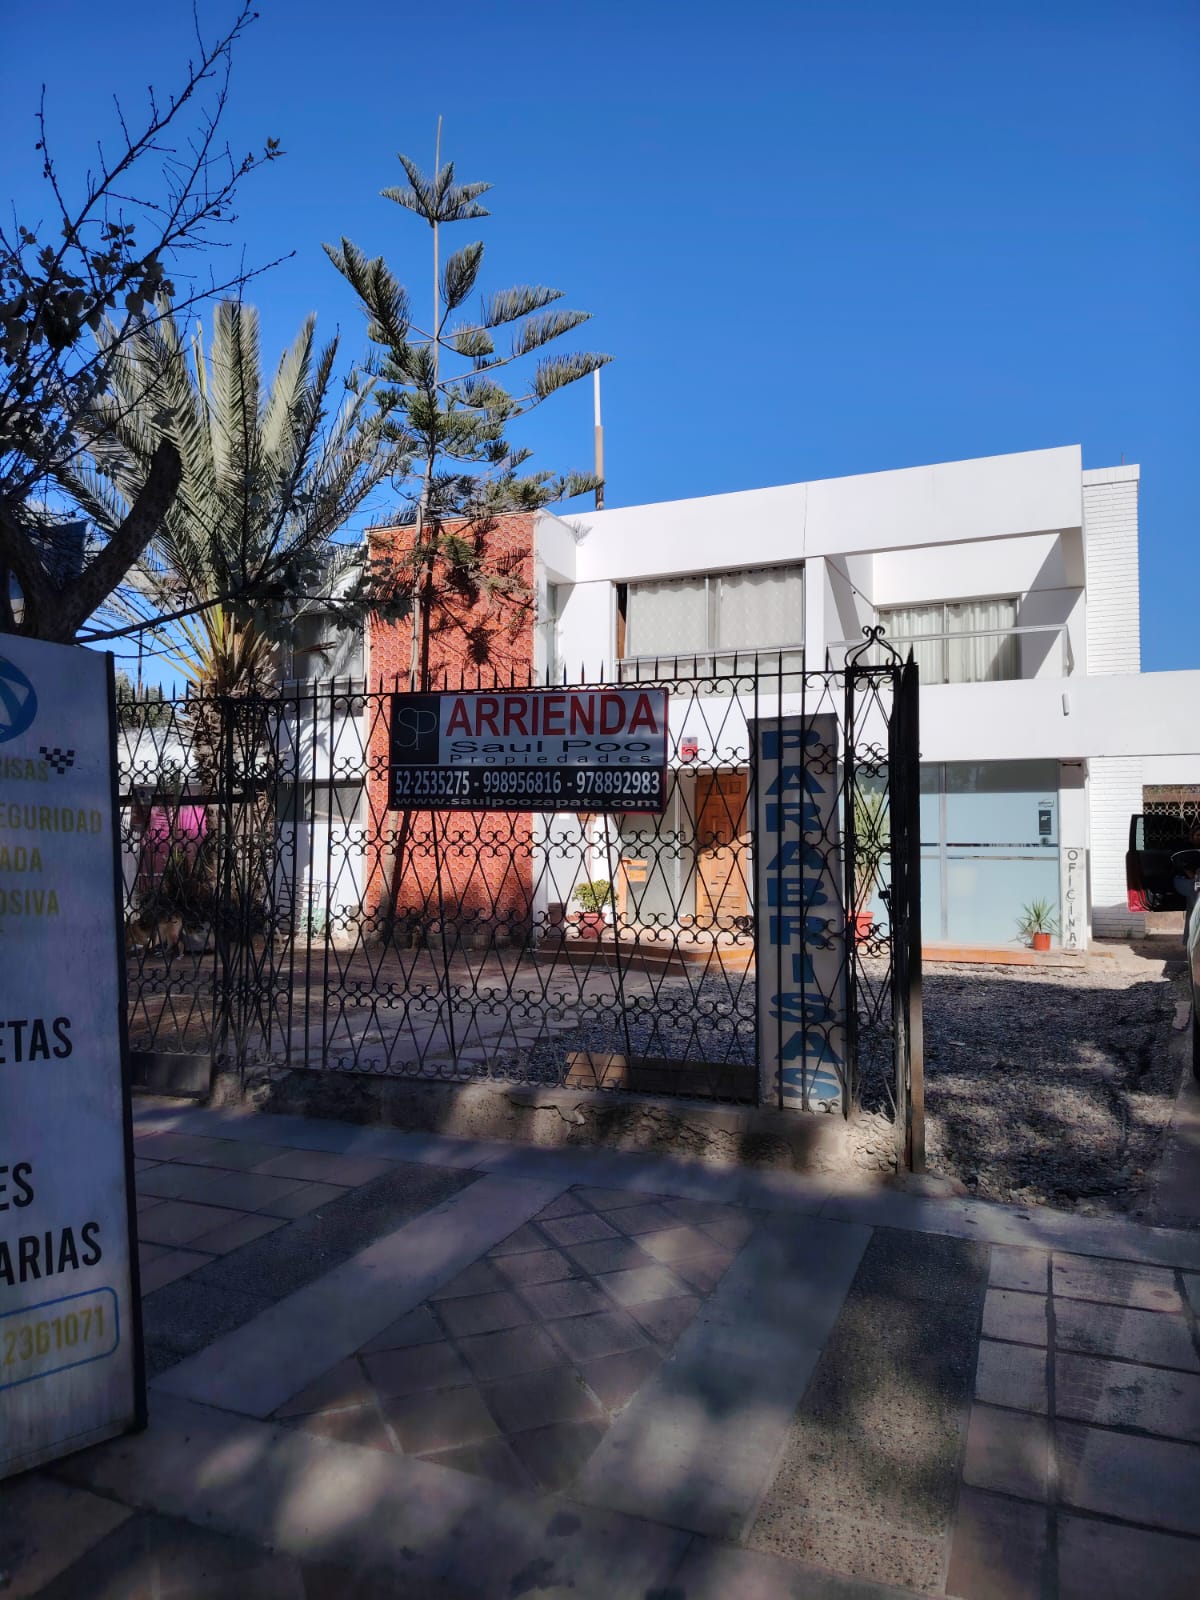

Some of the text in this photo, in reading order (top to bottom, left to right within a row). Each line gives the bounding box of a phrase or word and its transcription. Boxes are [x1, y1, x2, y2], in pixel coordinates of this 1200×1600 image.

[446, 693, 659, 737] ARRIENDA
[450, 739, 652, 753] Saul Poo
[450, 753, 651, 766] Propiedades
[0, 754, 49, 782] ISAS
[483, 770, 562, 794] 998956816
[576, 770, 660, 795] 978892983
[1066, 849, 1079, 942] OFICINA
[761, 729, 844, 1099] PARABRISAS
[0, 1221, 102, 1286] ARIAS
